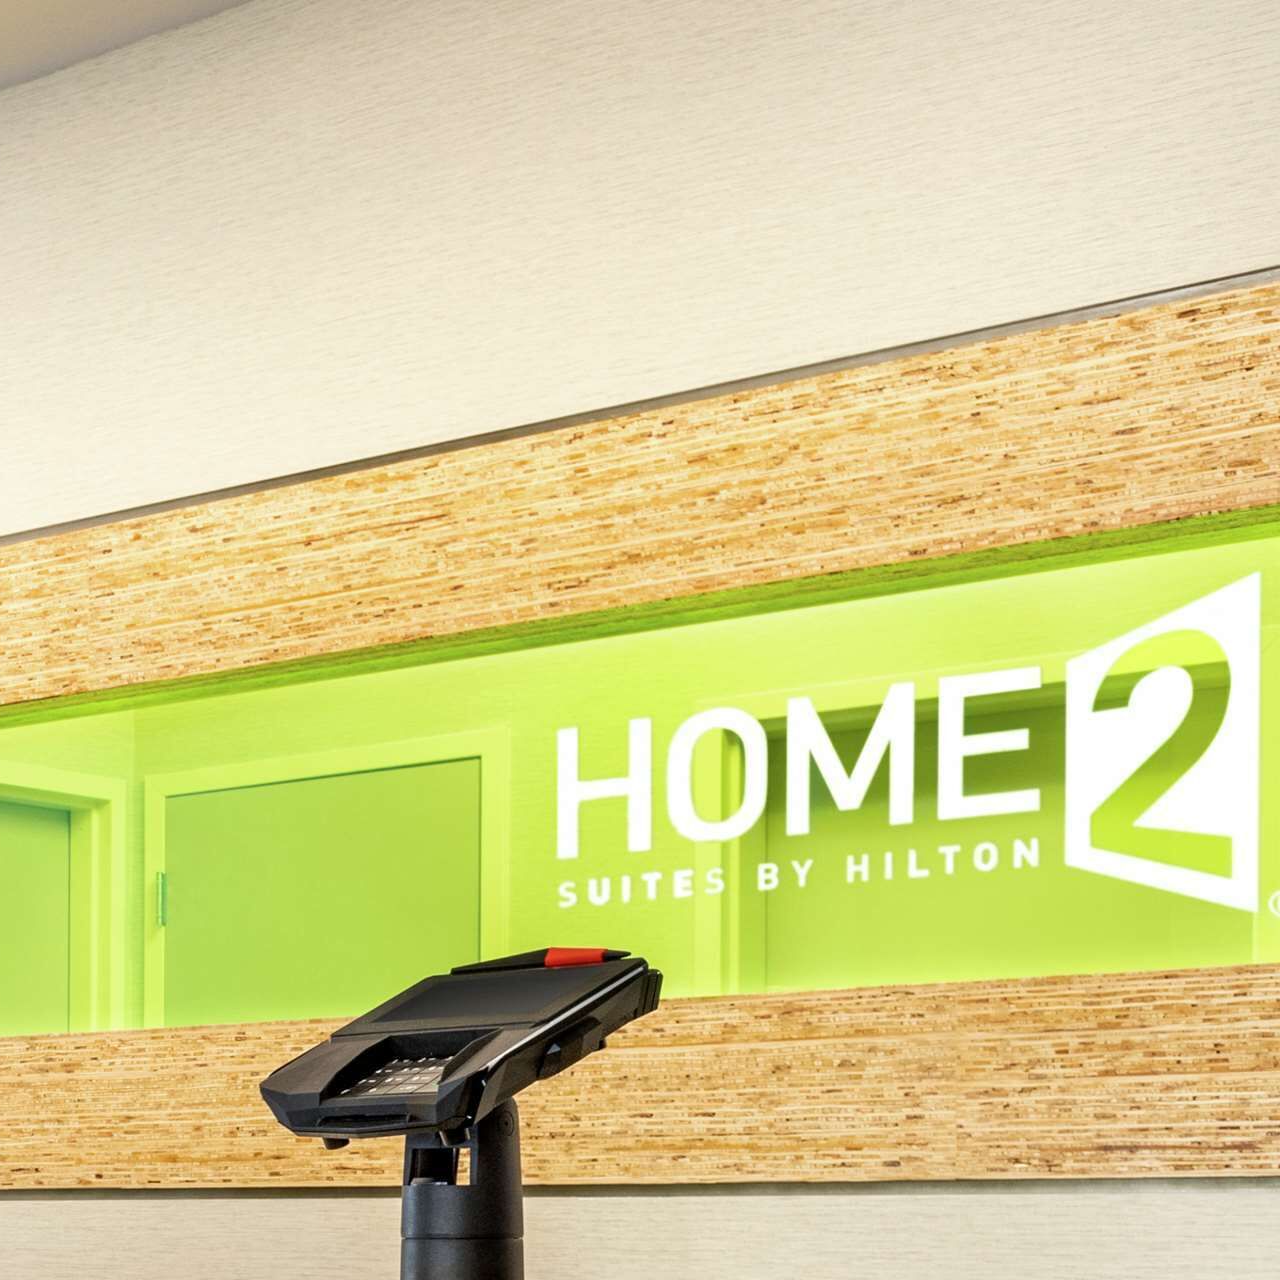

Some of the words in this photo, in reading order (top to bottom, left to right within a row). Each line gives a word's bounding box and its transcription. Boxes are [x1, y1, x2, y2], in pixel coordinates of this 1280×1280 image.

[556, 667, 1041, 859] HOME
[1090, 628, 1232, 880] 2
[558, 868, 725, 908] SUITES
[758, 860, 813, 890] BY
[847, 838, 1039, 885] HILTON
